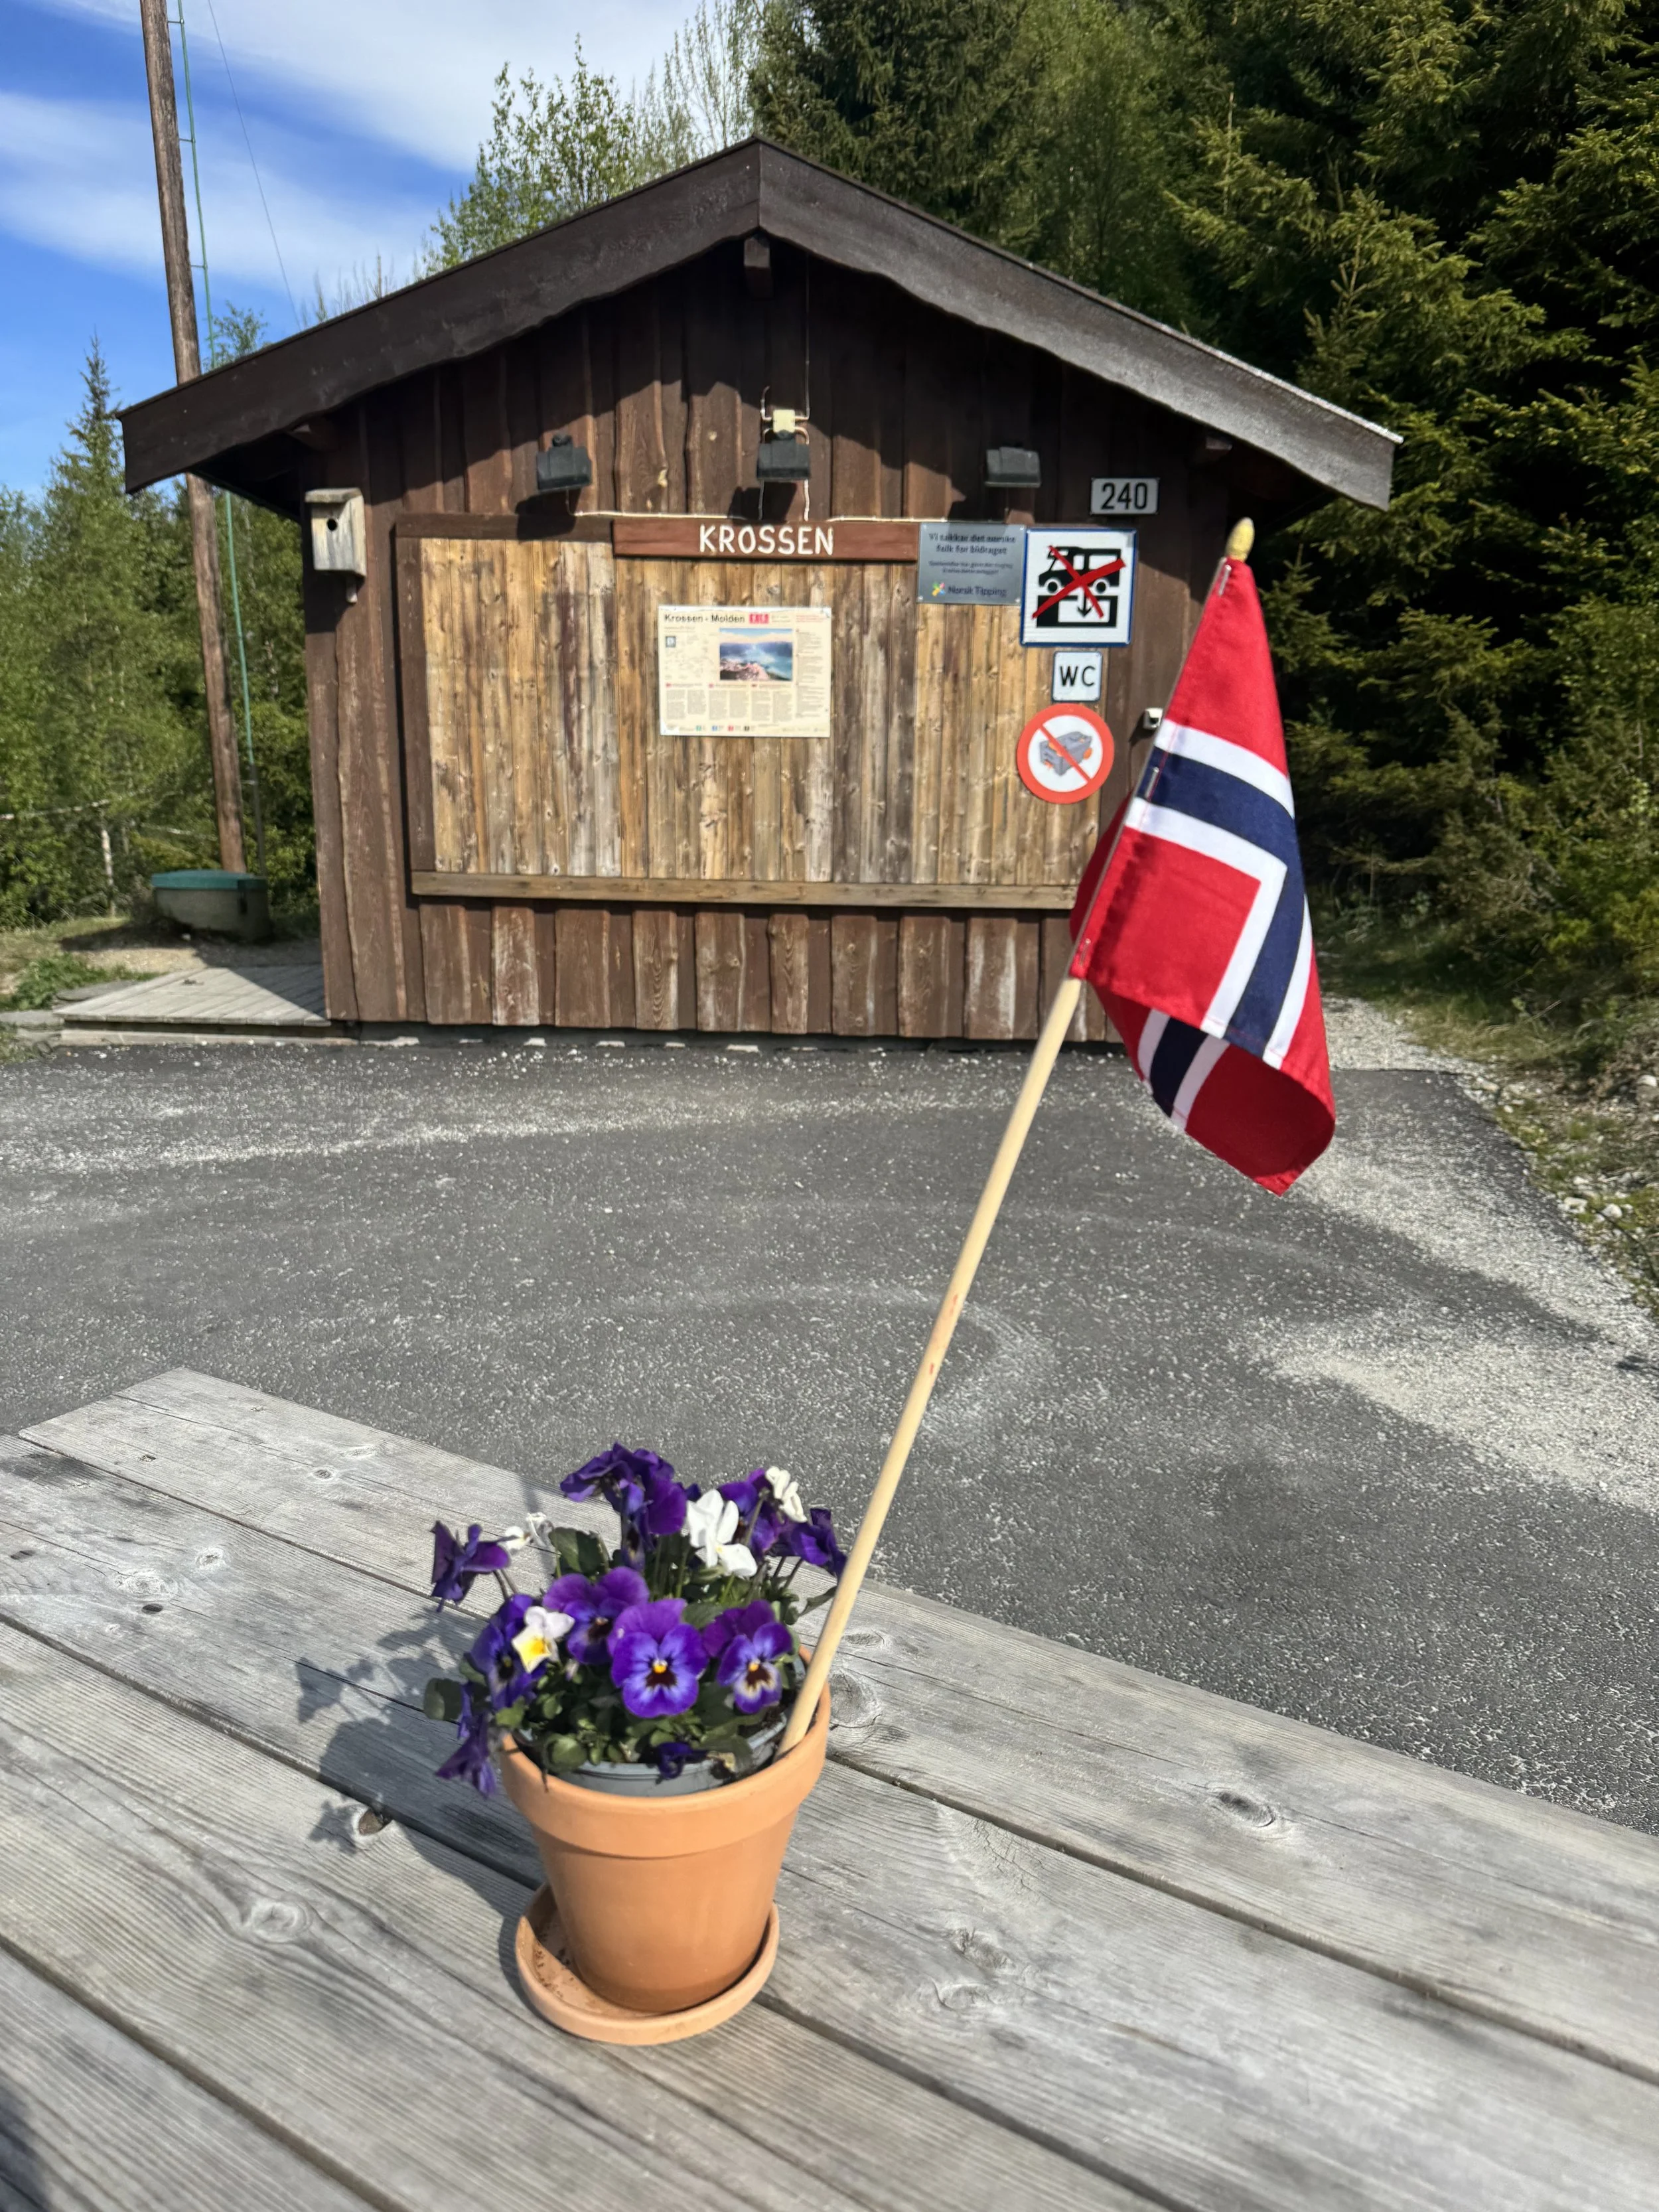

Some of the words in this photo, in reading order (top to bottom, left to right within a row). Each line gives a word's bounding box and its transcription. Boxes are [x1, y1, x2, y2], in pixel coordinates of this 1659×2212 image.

[1101, 482, 1148, 510] 240
[699, 524, 833, 555] KROSSEN
[948, 586, 973, 595] Norsk
[974, 586, 1007, 597] Tipping
[664, 613, 703, 623] Krossen
[711, 613, 745, 623] Molden
[1060, 666, 1096, 686] WC
